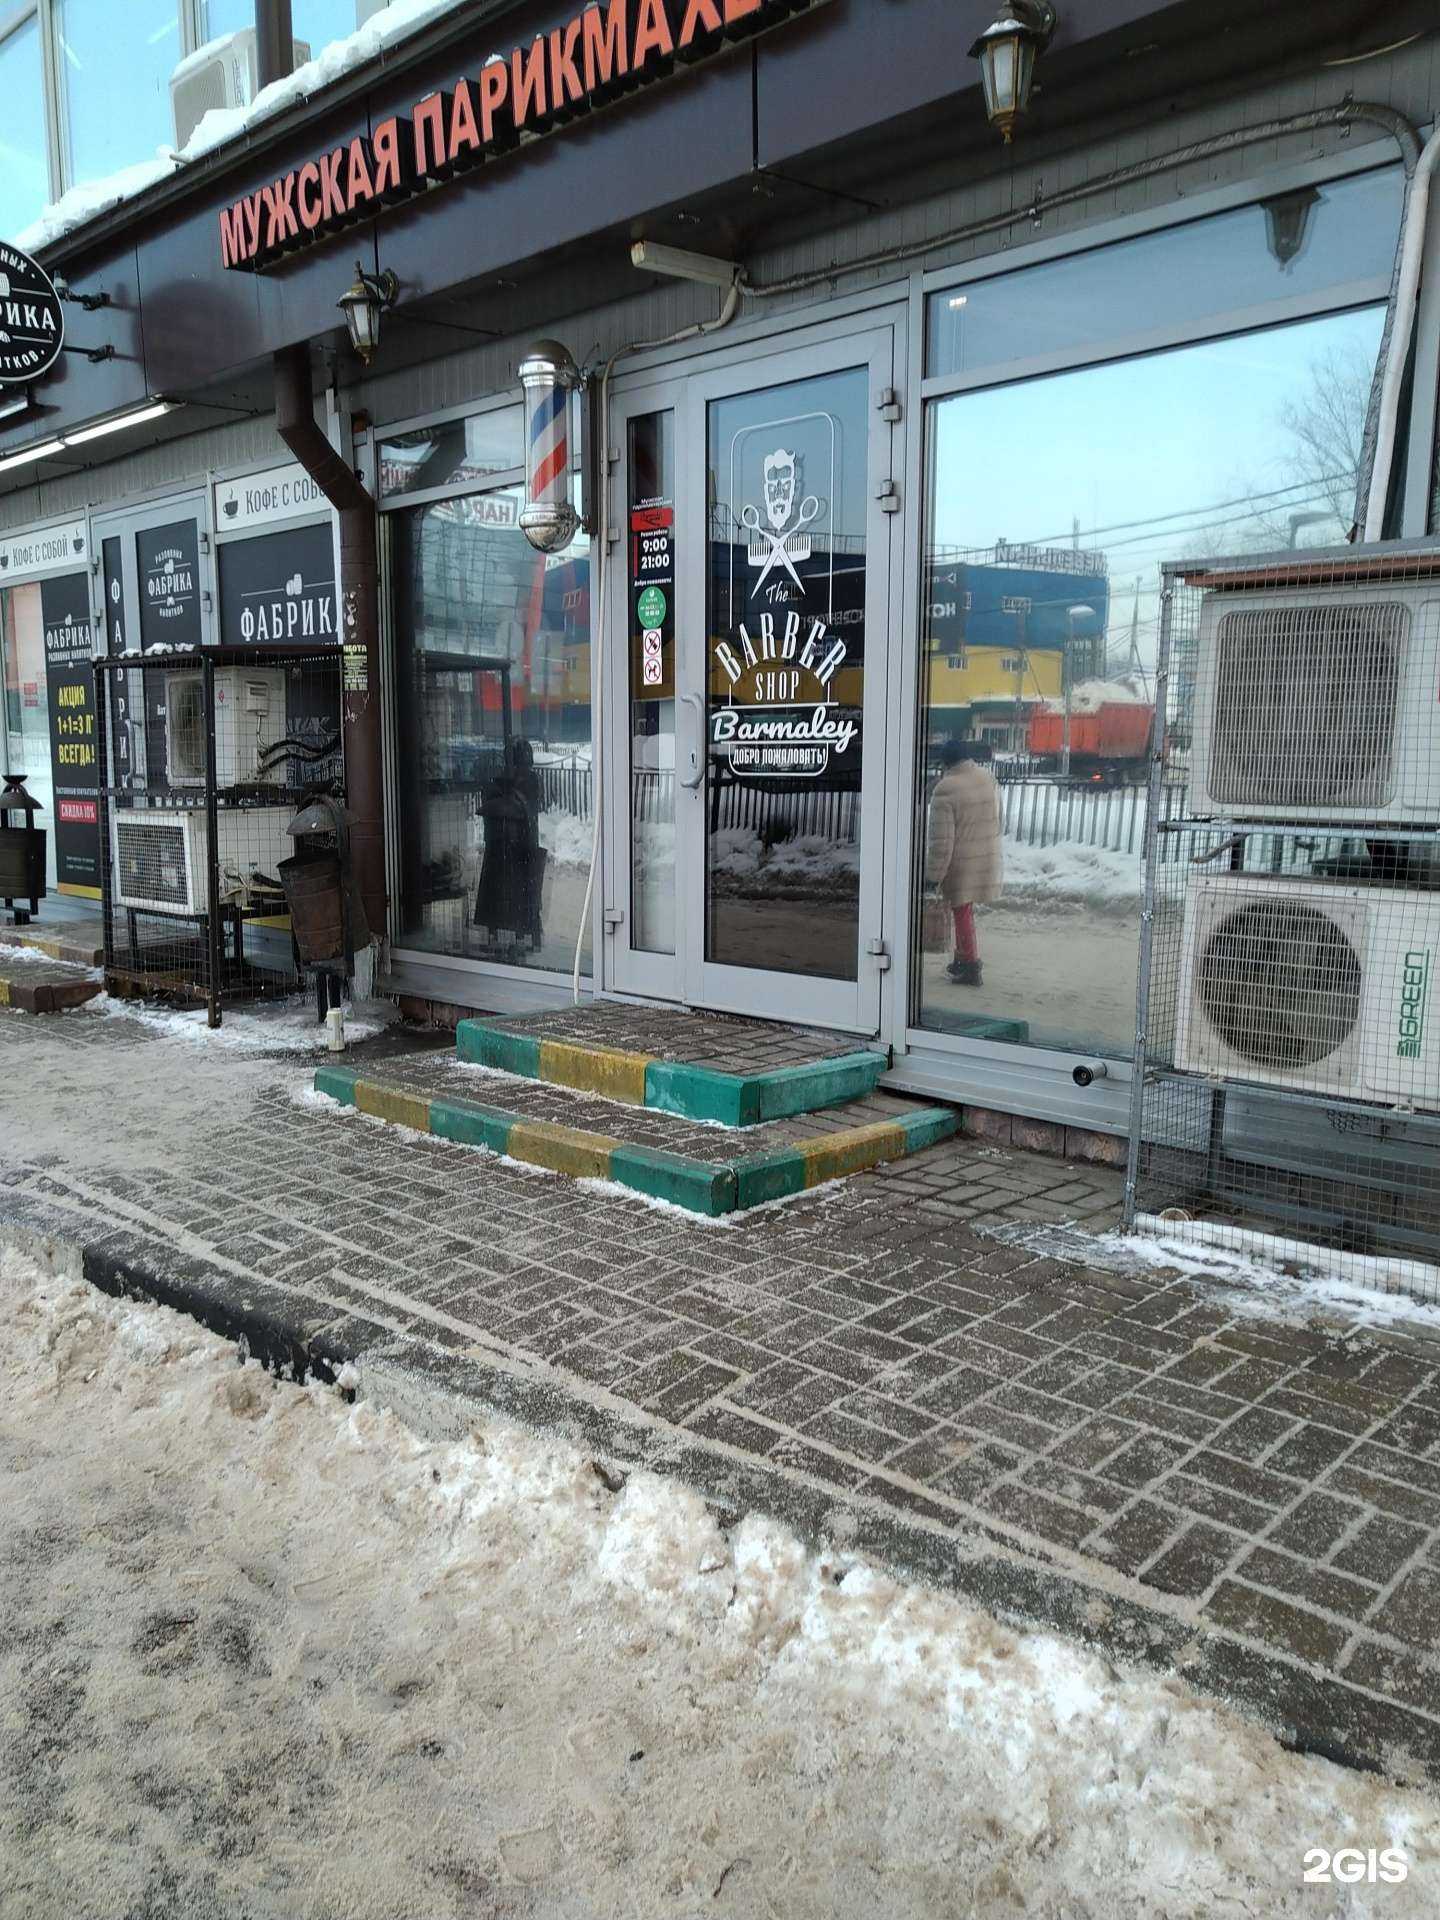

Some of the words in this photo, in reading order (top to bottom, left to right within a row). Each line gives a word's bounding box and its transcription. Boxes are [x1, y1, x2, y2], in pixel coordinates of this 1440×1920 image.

[219, 117, 400, 268] МУЖСКАЯ
[412, 0, 762, 175] ПАРИКМАХ
[0, 301, 56, 331] ИКА
[0, 349, 39, 369] ТКОВ
[245, 486, 279, 514] КОФЕ
[282, 483, 289, 506] С
[13, 545, 33, 568] КОФЕ
[35, 544, 40, 562] С
[41, 533, 68, 560] СОБОЙ
[643, 537, 667, 553] 9:00
[641, 554, 669, 569] 21:00
[148, 572, 193, 596] ФАБРИКА
[766, 581, 789, 604] The
[241, 597, 338, 641] ФАБРИК
[46, 625, 91, 649] ФАБРИКА
[715, 610, 847, 686] BARBER
[59, 686, 86, 708] АКЦИЯ
[755, 671, 799, 701] SHOP
[57, 715, 84, 735] 1+1=3
[711, 706, 858, 753] Barmaley
[58, 744, 95, 767] ВСЕГДА!
[733, 748, 760, 765] ДОБРО
[1399, 951, 1424, 1037] GREEN
